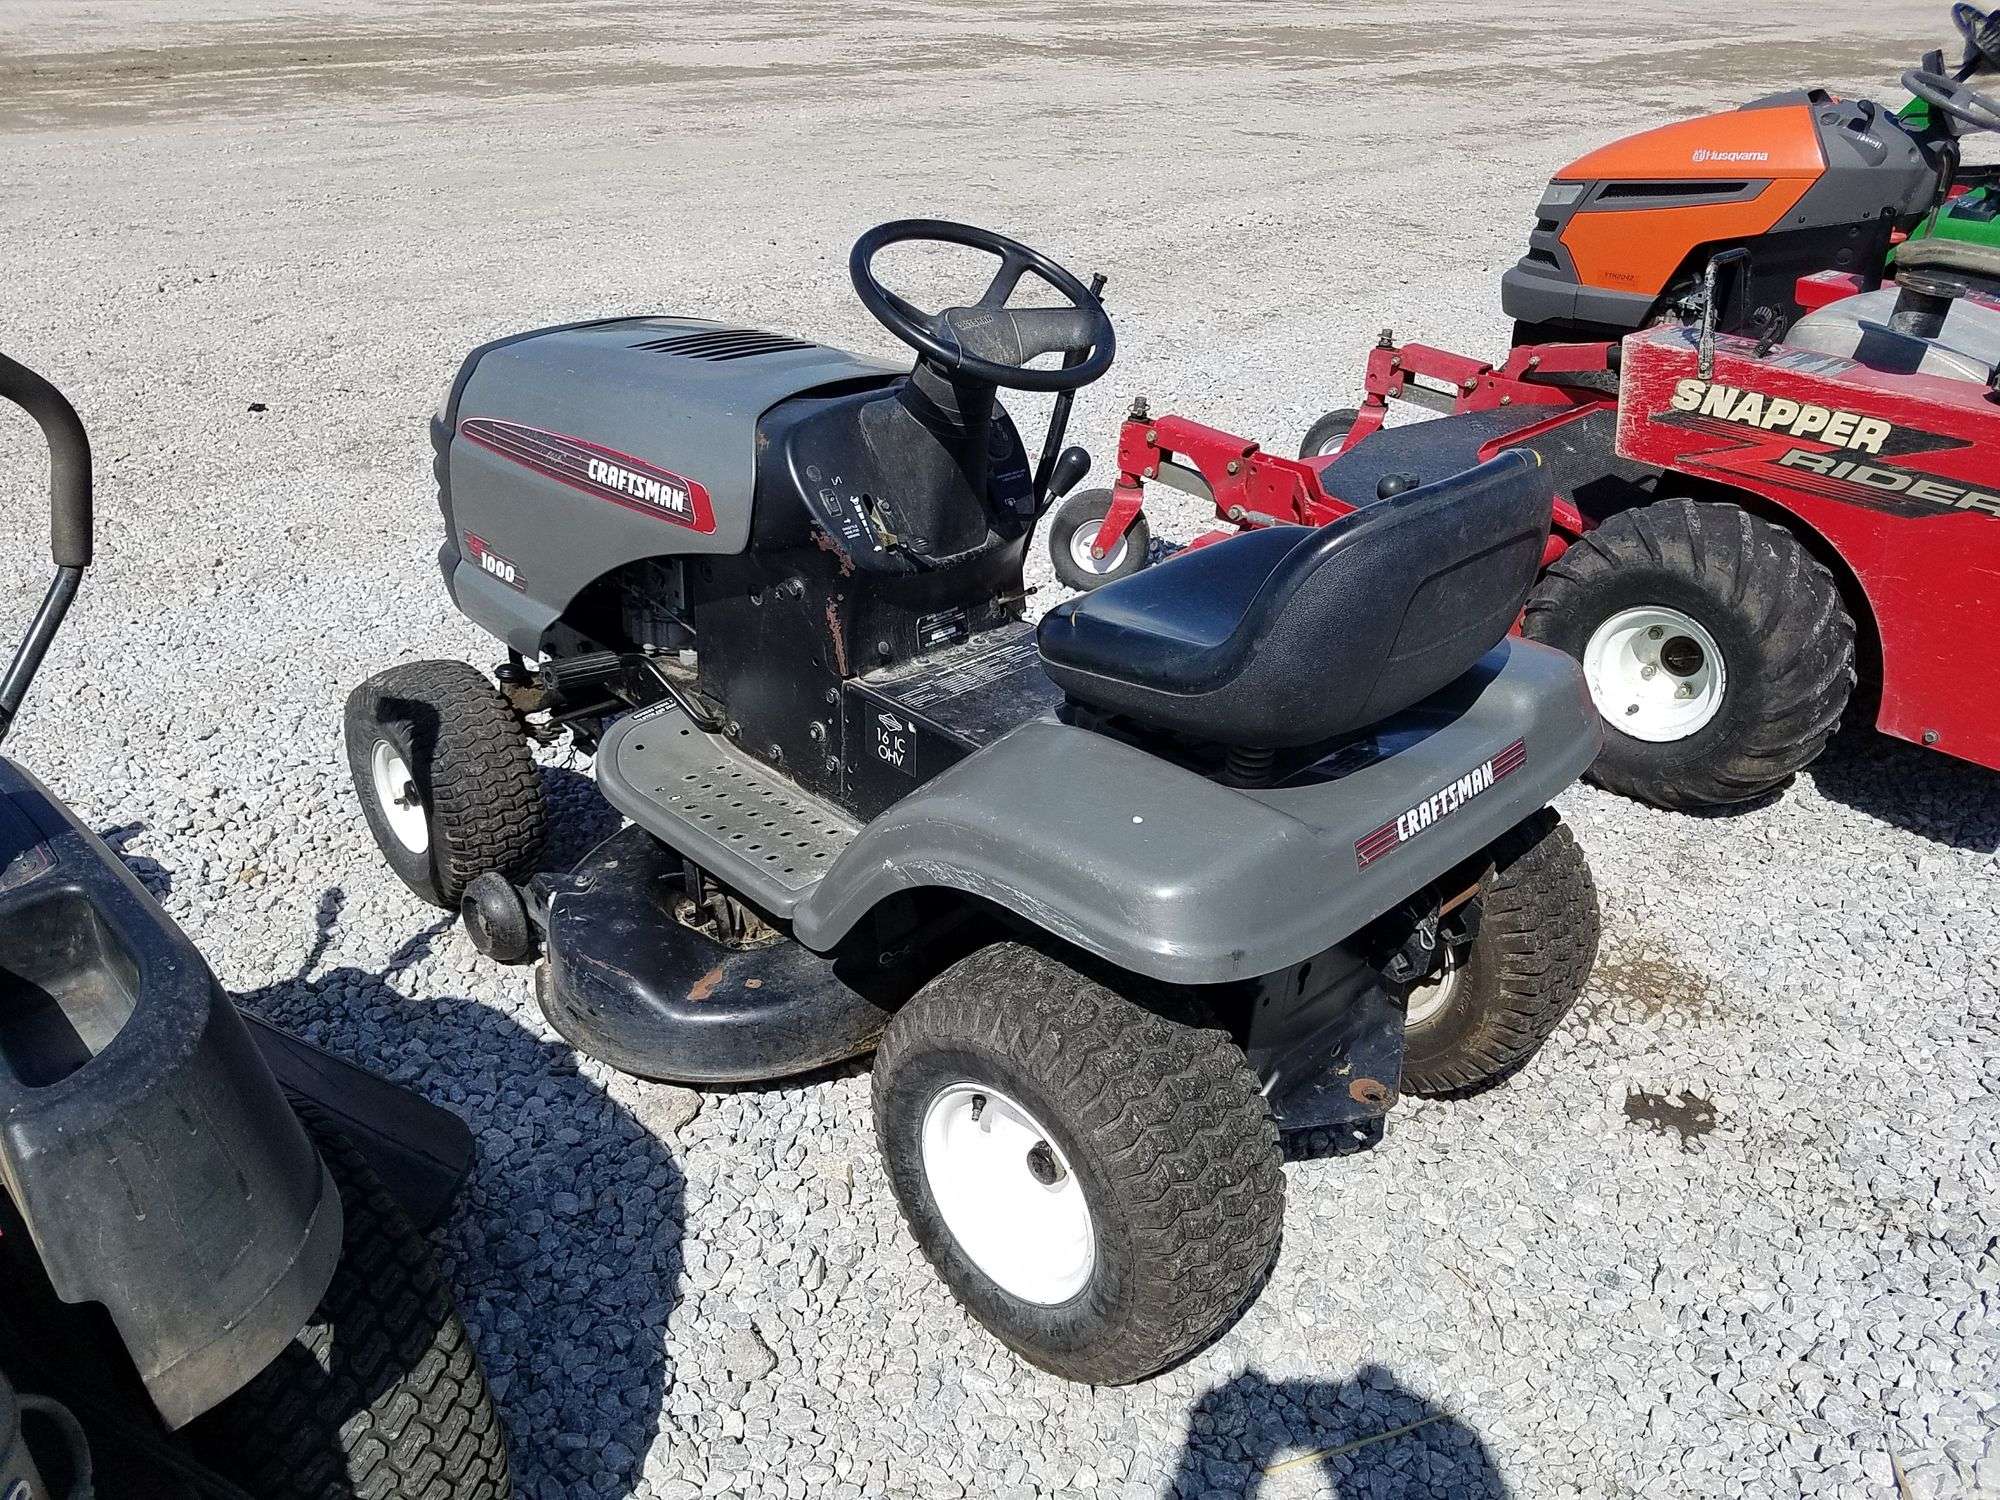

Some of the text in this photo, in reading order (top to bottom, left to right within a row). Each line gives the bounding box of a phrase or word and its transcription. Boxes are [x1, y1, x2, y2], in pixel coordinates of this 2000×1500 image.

[1705, 150, 1769, 162] Husqvarna
[1671, 379, 1892, 455] SNAPPER
[588, 458, 685, 513] CRAFTSMAN
[1777, 448, 2000, 517] RIDER
[481, 551, 516, 583] 1000
[876, 727, 906, 754] 16 IC
[877, 744, 904, 767] OHV
[1396, 760, 1495, 842] CRAFTSMAN
